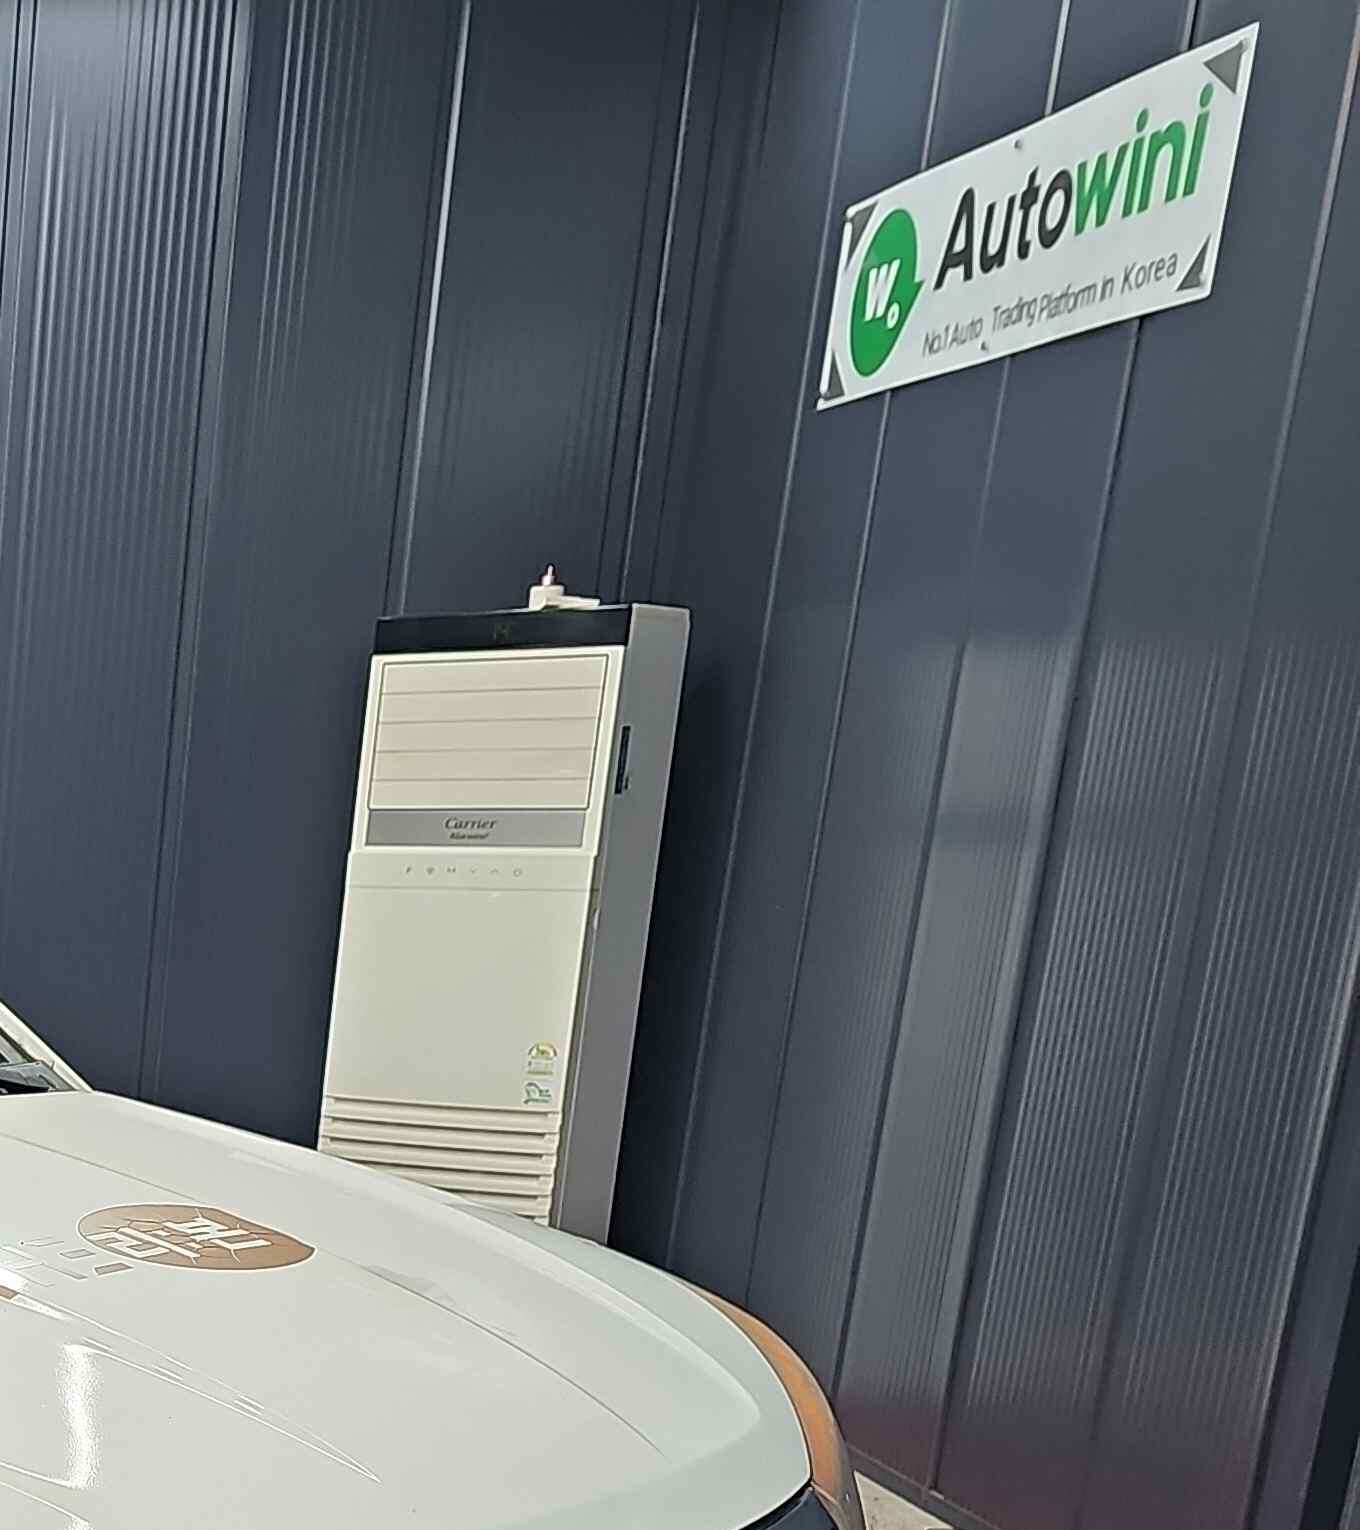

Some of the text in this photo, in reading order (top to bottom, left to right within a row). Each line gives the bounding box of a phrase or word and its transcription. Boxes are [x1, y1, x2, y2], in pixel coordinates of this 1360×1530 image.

[933, 83, 1214, 290] Autowini
[922, 253, 1179, 357] No.1 Auto Trading Platform in Korea
[443, 816, 498, 830] Carrier
